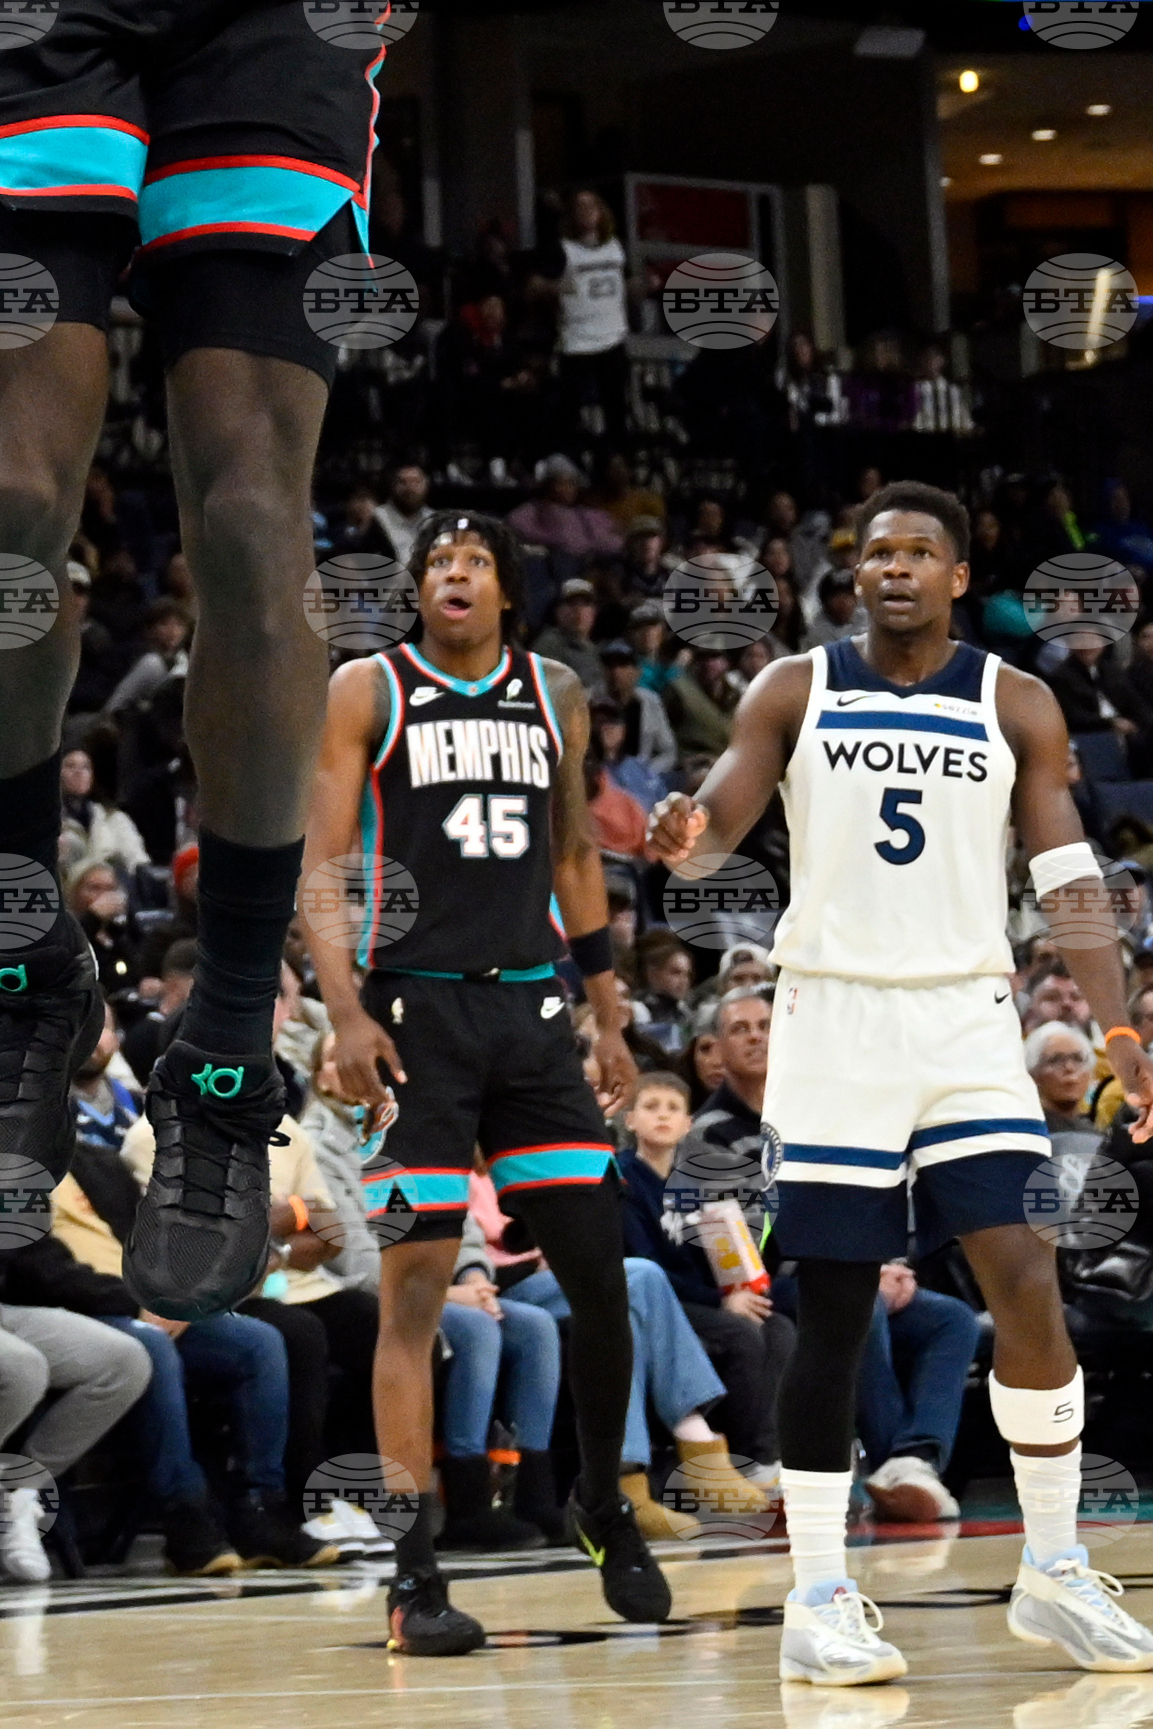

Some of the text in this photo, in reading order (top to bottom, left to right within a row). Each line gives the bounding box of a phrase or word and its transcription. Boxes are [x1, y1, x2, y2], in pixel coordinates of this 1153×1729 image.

[405, 719, 550, 790] MEMPHIS
[822, 740, 988, 782] WOLVES
[441, 793, 530, 860] 45
[873, 786, 926, 866] 5
[1052, 1401, 1074, 1423] 5
